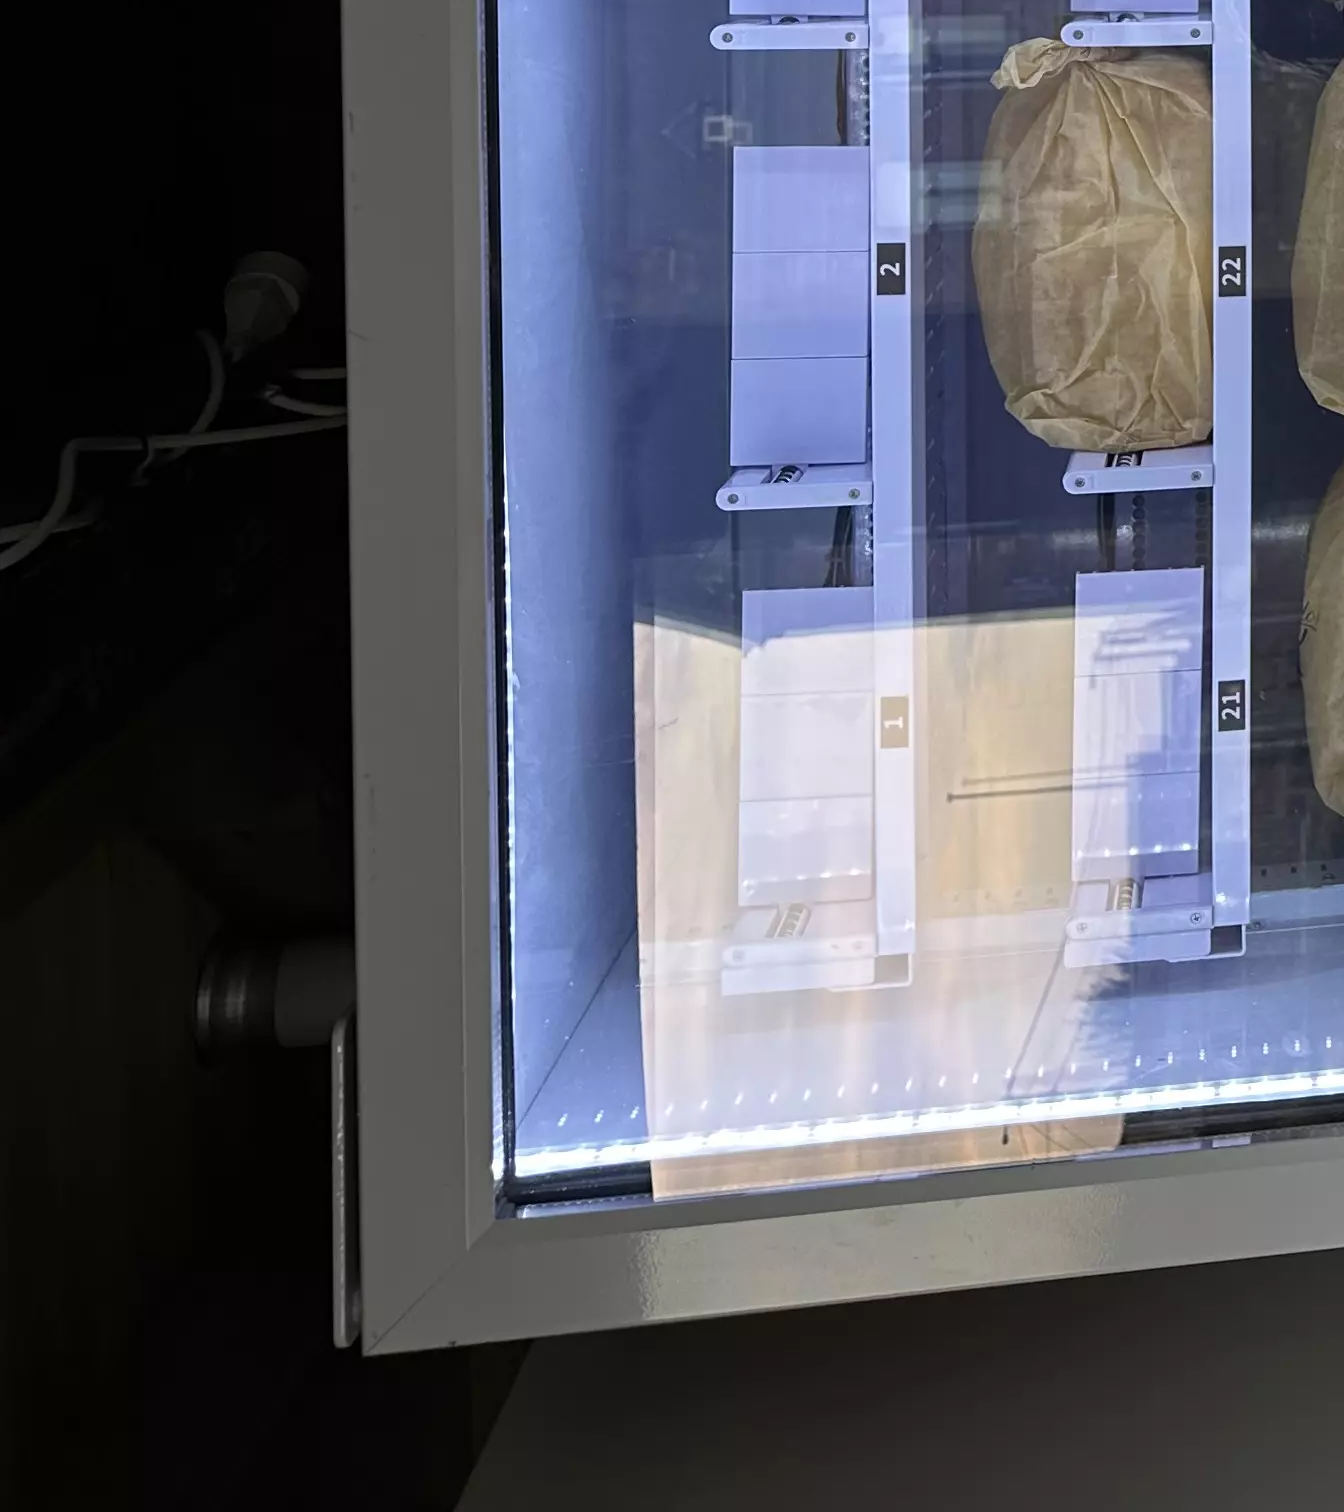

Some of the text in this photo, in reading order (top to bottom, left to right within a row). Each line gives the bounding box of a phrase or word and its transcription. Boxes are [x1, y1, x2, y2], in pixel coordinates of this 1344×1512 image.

[880, 263, 899, 275] 2
[1222, 258, 1240, 285] 22
[1222, 692, 1240, 719] 21
[884, 717, 903, 728] 1
